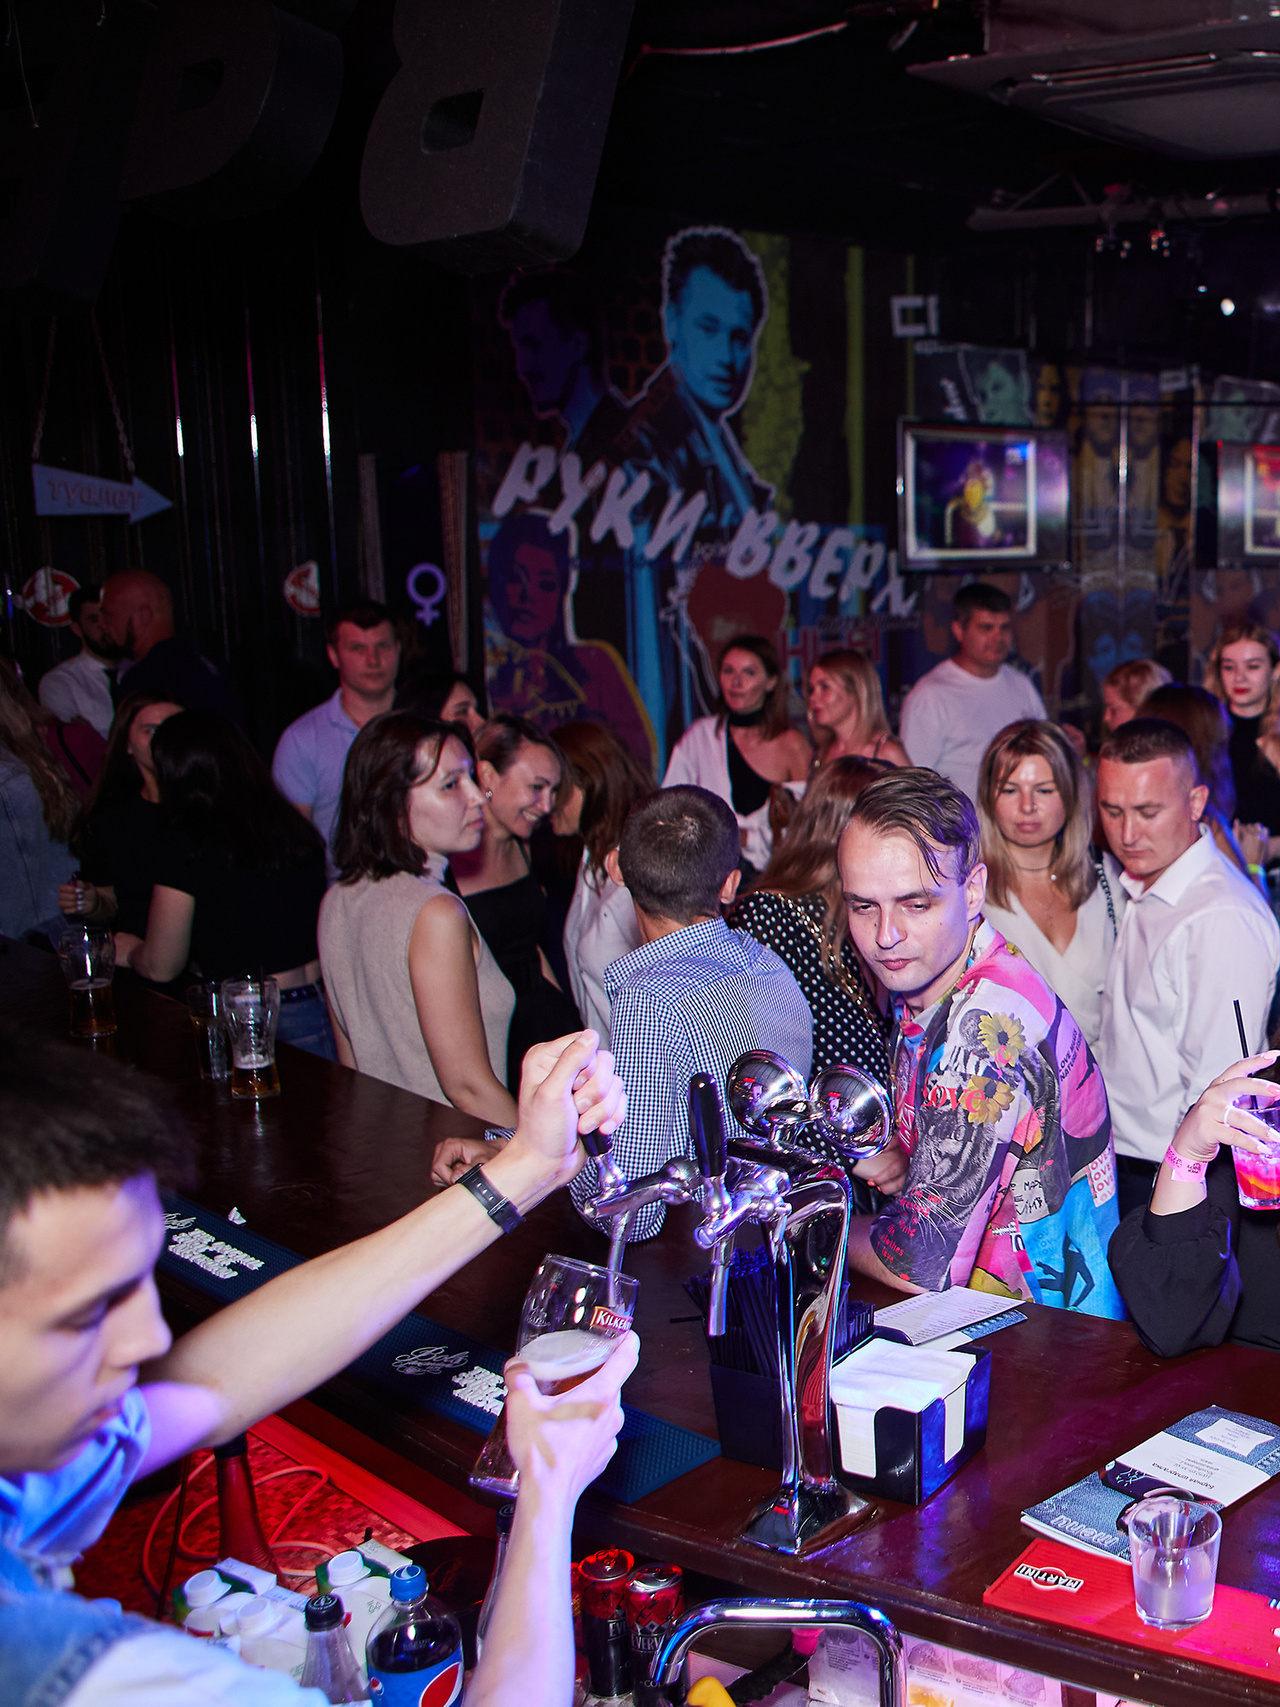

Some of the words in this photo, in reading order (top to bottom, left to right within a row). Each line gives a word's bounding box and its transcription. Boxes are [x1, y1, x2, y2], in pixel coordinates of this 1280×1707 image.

[491, 441, 709, 563] РУКИ
[725, 505, 918, 618] ВВЕРХ
[880, 1234, 904, 1256] clothes
[1050, 1514, 1120, 1547] menu
[1017, 1564, 1082, 1590] MARTINI
